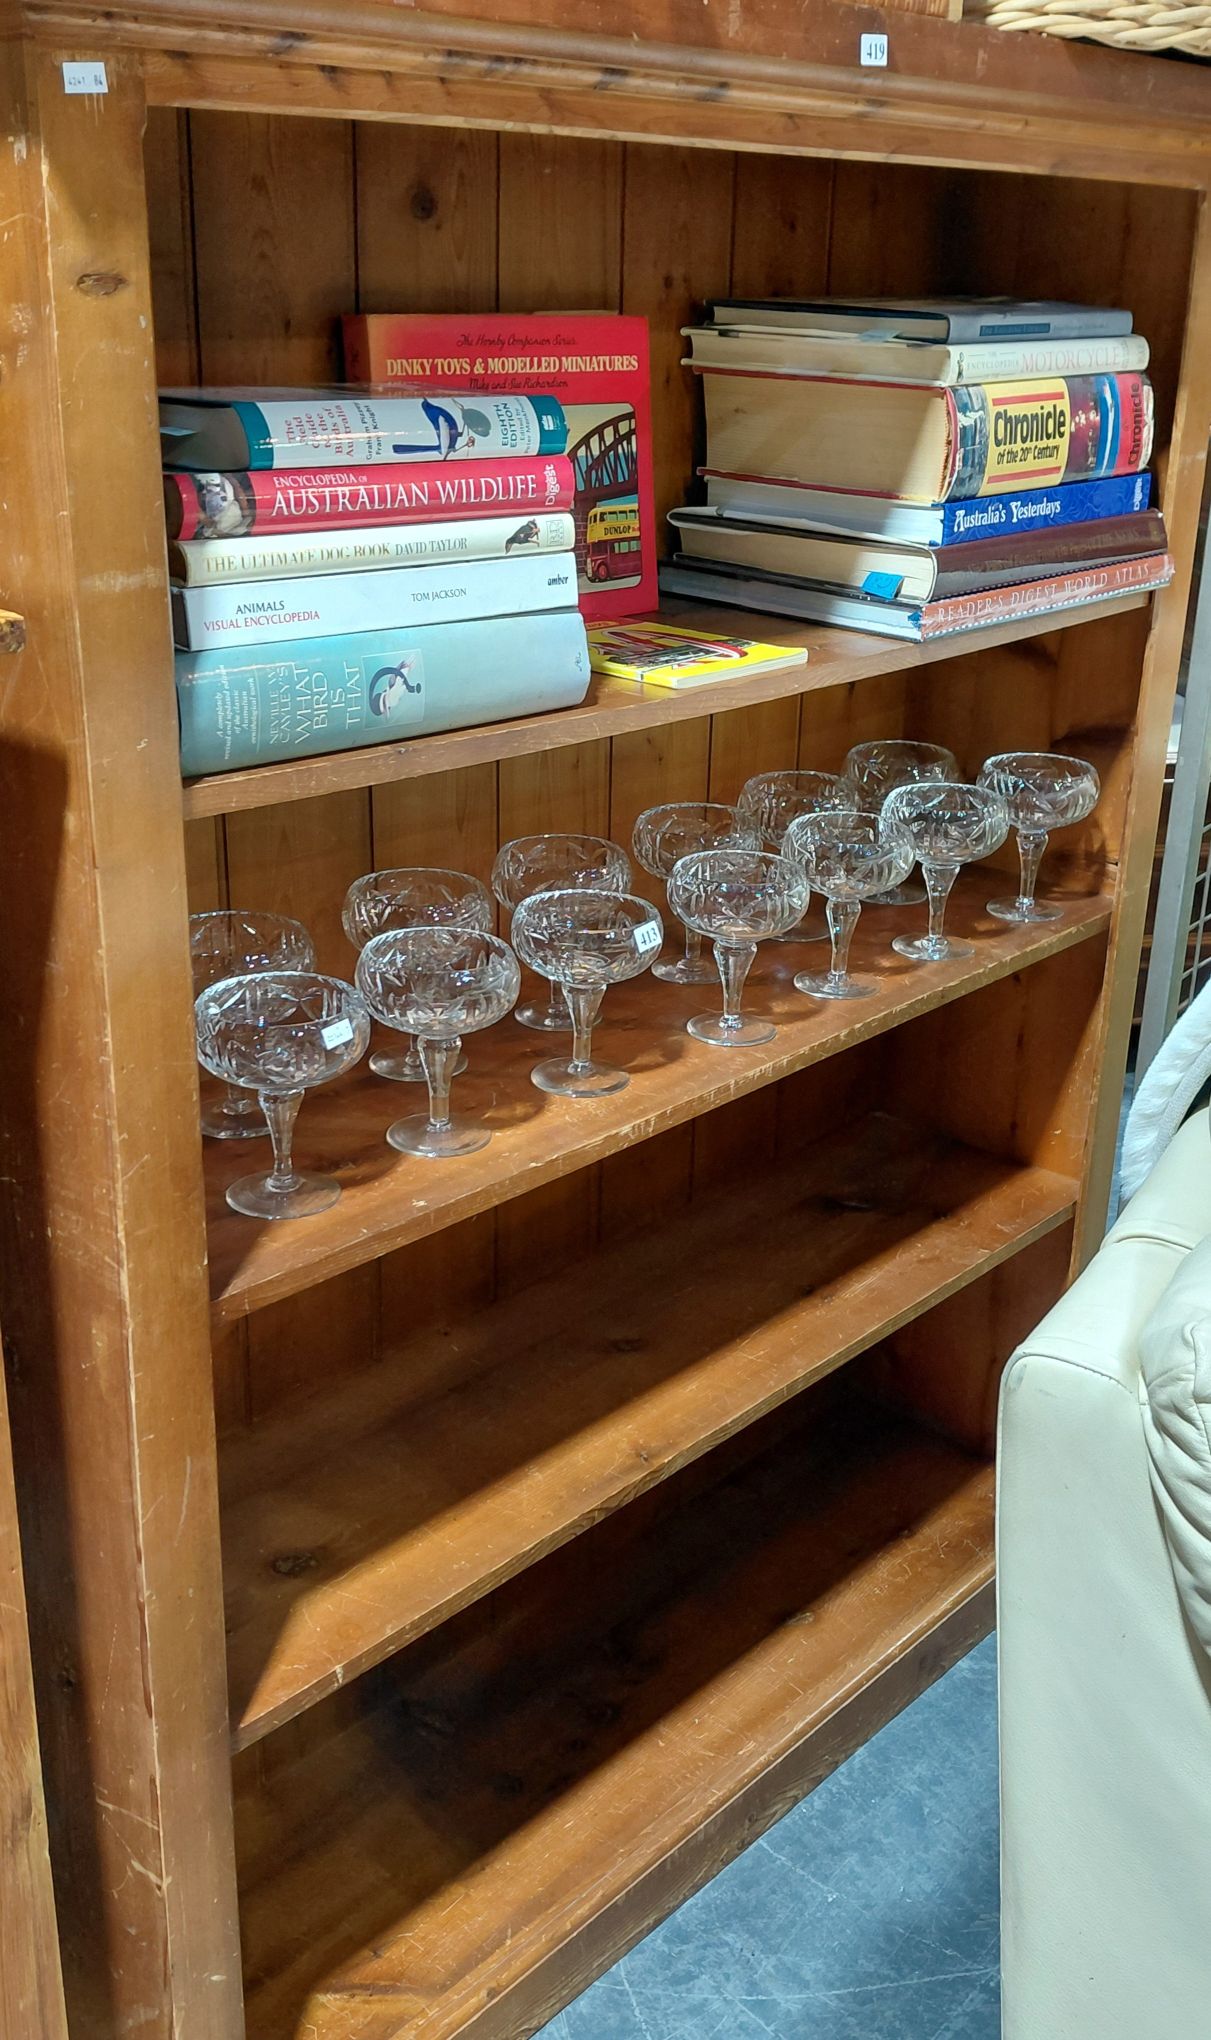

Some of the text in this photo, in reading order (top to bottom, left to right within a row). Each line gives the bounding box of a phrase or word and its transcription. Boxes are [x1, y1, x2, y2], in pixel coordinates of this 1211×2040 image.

[867, 43, 885, 60] 419
[456, 334, 473, 347] The
[475, 334, 505, 351] Hornby
[508, 334, 551, 350] Companion
[386, 355, 639, 376] DINKY TOYS & MODELLED MINIATURES
[1022, 346, 1120, 373] MOTORCYCLE
[469, 378, 489, 390] Mike
[491, 379, 506, 390] and
[522, 377, 568, 389] Richardson
[317, 413, 328, 432] the
[364, 404, 379, 430] Knight
[493, 404, 509, 446] EIGHTH
[501, 402, 518, 448] EDITION
[993, 404, 1066, 448] Chronicle
[1127, 383, 1144, 466] Chronicle
[997, 452, 1005, 465] of
[1006, 449, 1018, 463] the
[1033, 444, 1060, 460] Century
[273, 473, 357, 488] ENCYCLOPEDIA
[545, 463, 560, 506] Digest
[271, 474, 538, 518] AUSTRALIAN WILDLIFE
[953, 497, 1061, 533] Australia's Yesterdays
[603, 525, 632, 536] DUNLOP
[205, 537, 467, 573] THE ULTIMATE DOG BOOK DAVID TAYLOR
[547, 574, 569, 586] amber
[411, 588, 467, 602] TOM JACKSON
[938, 564, 1150, 623] READER'S DIGEST WORLD ATLAS
[235, 600, 285, 615] ANIMALS
[204, 610, 321, 632] VISUAL ENCYCLOPEDIA
[276, 666, 292, 743] CAYLEY'S
[291, 661, 313, 744] WHAT
[312, 672, 329, 729] BIRD
[330, 688, 345, 709] IS
[343, 661, 362, 730] THAT
[269, 689, 281, 744] NEVILLE
[641, 927, 658, 945] 413
